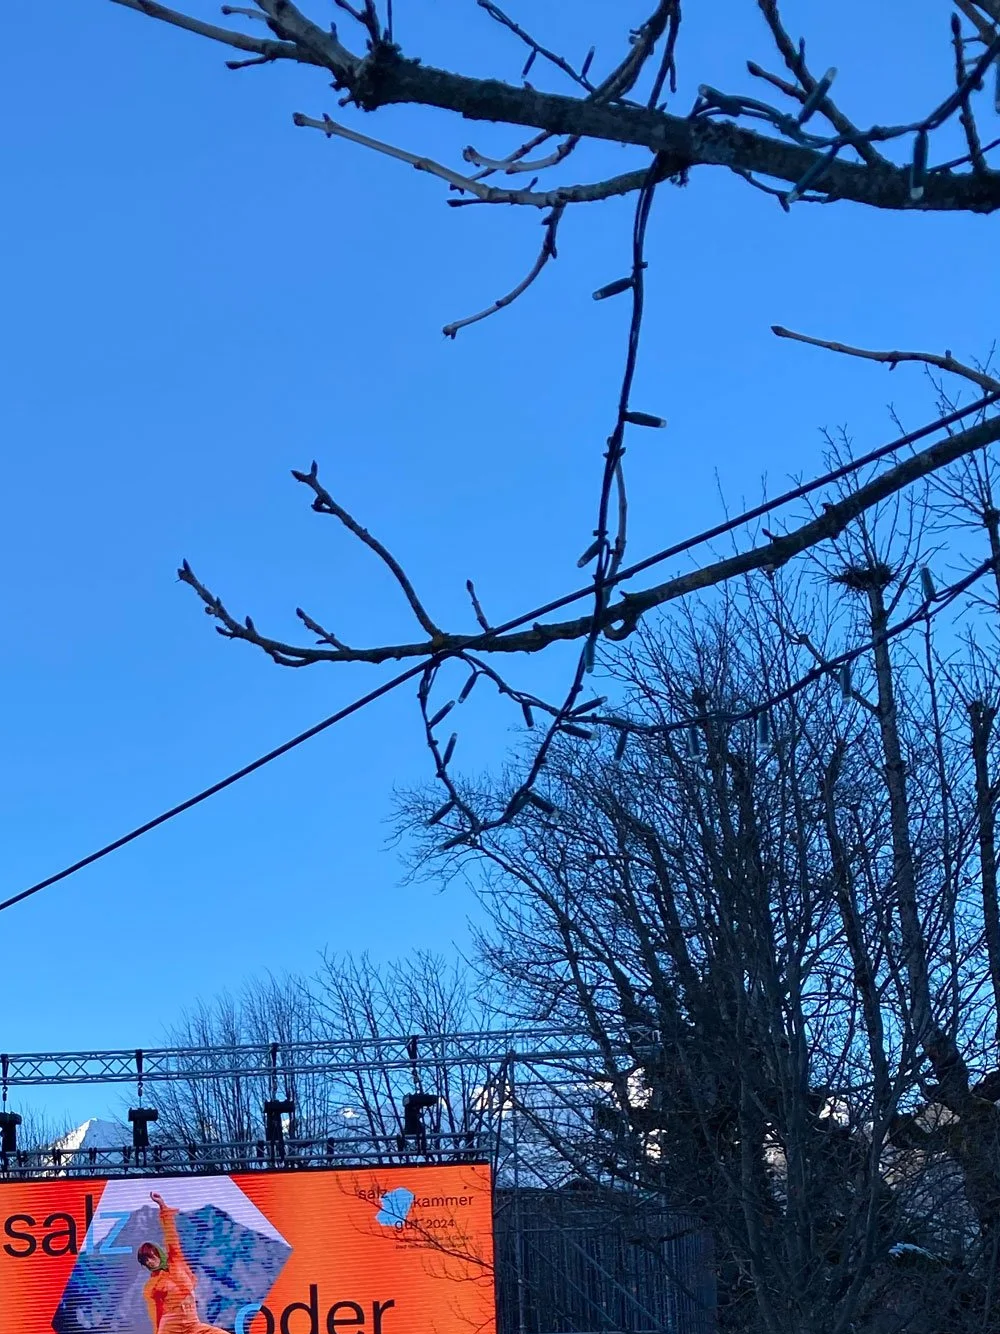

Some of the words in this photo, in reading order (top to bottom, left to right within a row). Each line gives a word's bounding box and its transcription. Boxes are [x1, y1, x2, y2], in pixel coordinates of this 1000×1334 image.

[358, 1187, 389, 1199] salz
[413, 1194, 474, 1208] kammer
[2, 1194, 135, 1258] salz
[395, 1219, 420, 1233] gut
[426, 1218, 455, 1229] 2024
